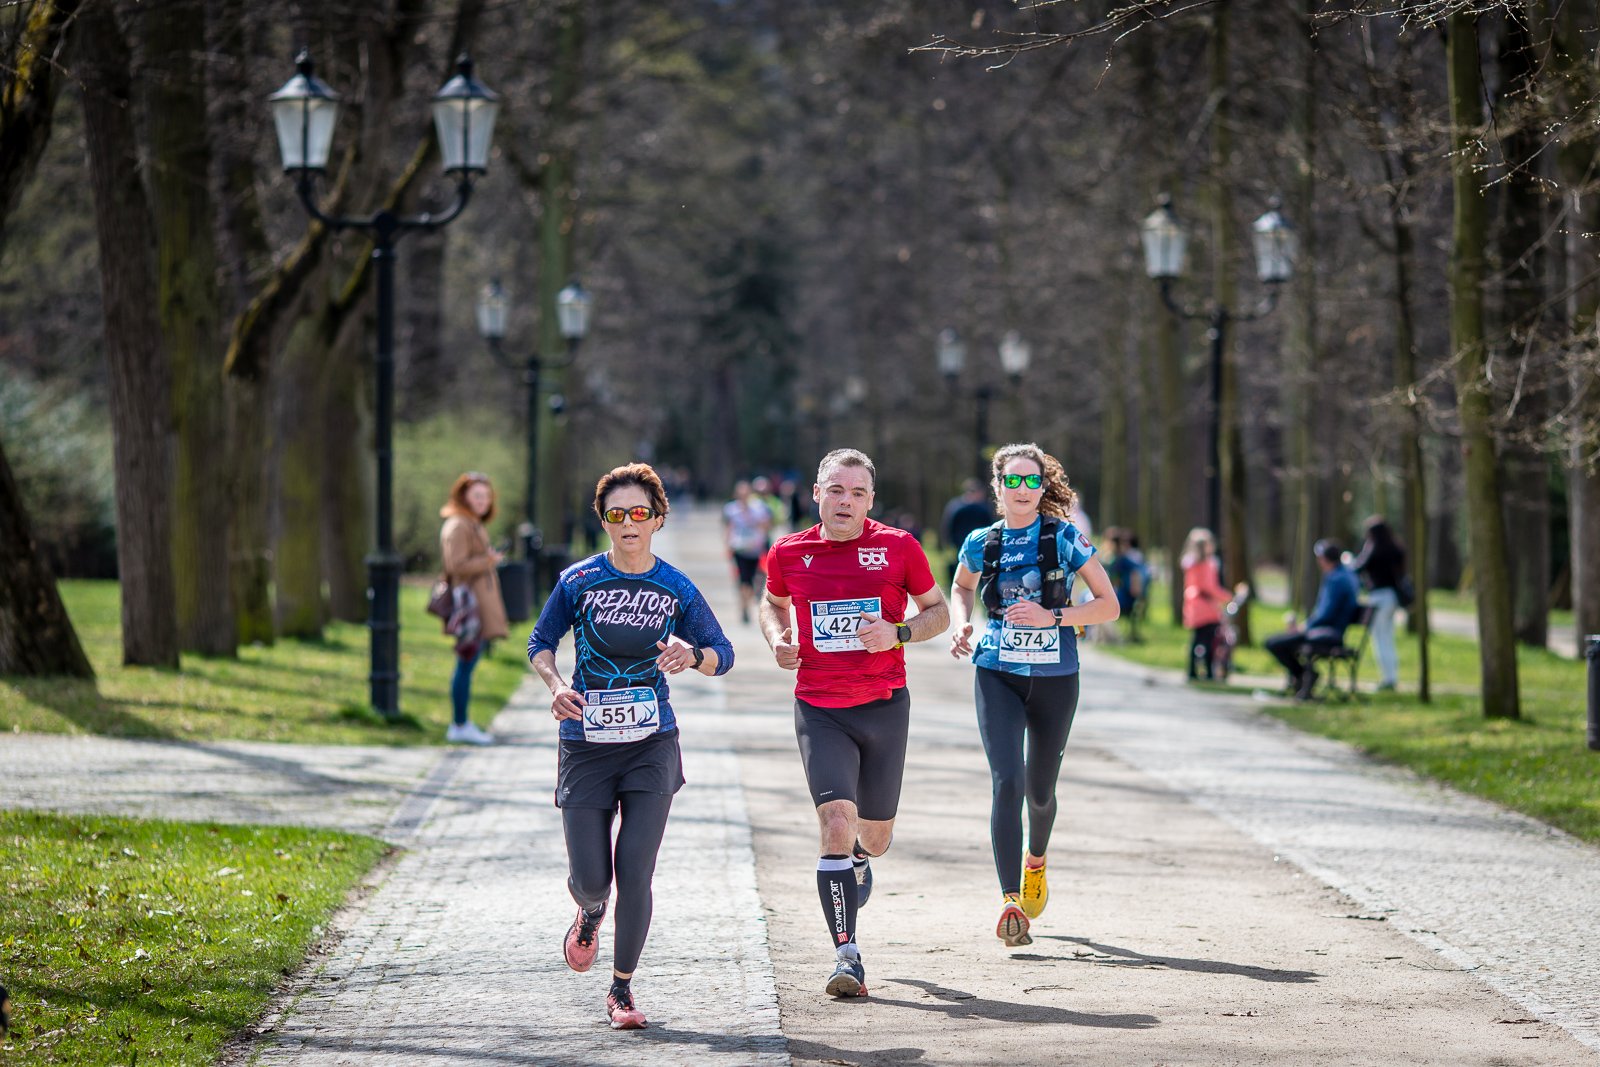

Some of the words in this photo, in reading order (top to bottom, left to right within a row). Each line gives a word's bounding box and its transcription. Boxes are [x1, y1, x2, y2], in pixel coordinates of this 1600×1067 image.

[582, 588, 679, 616] PREDATORS
[829, 617, 863, 634] 427
[1013, 632, 1044, 647] 574
[602, 706, 636, 724] 551
